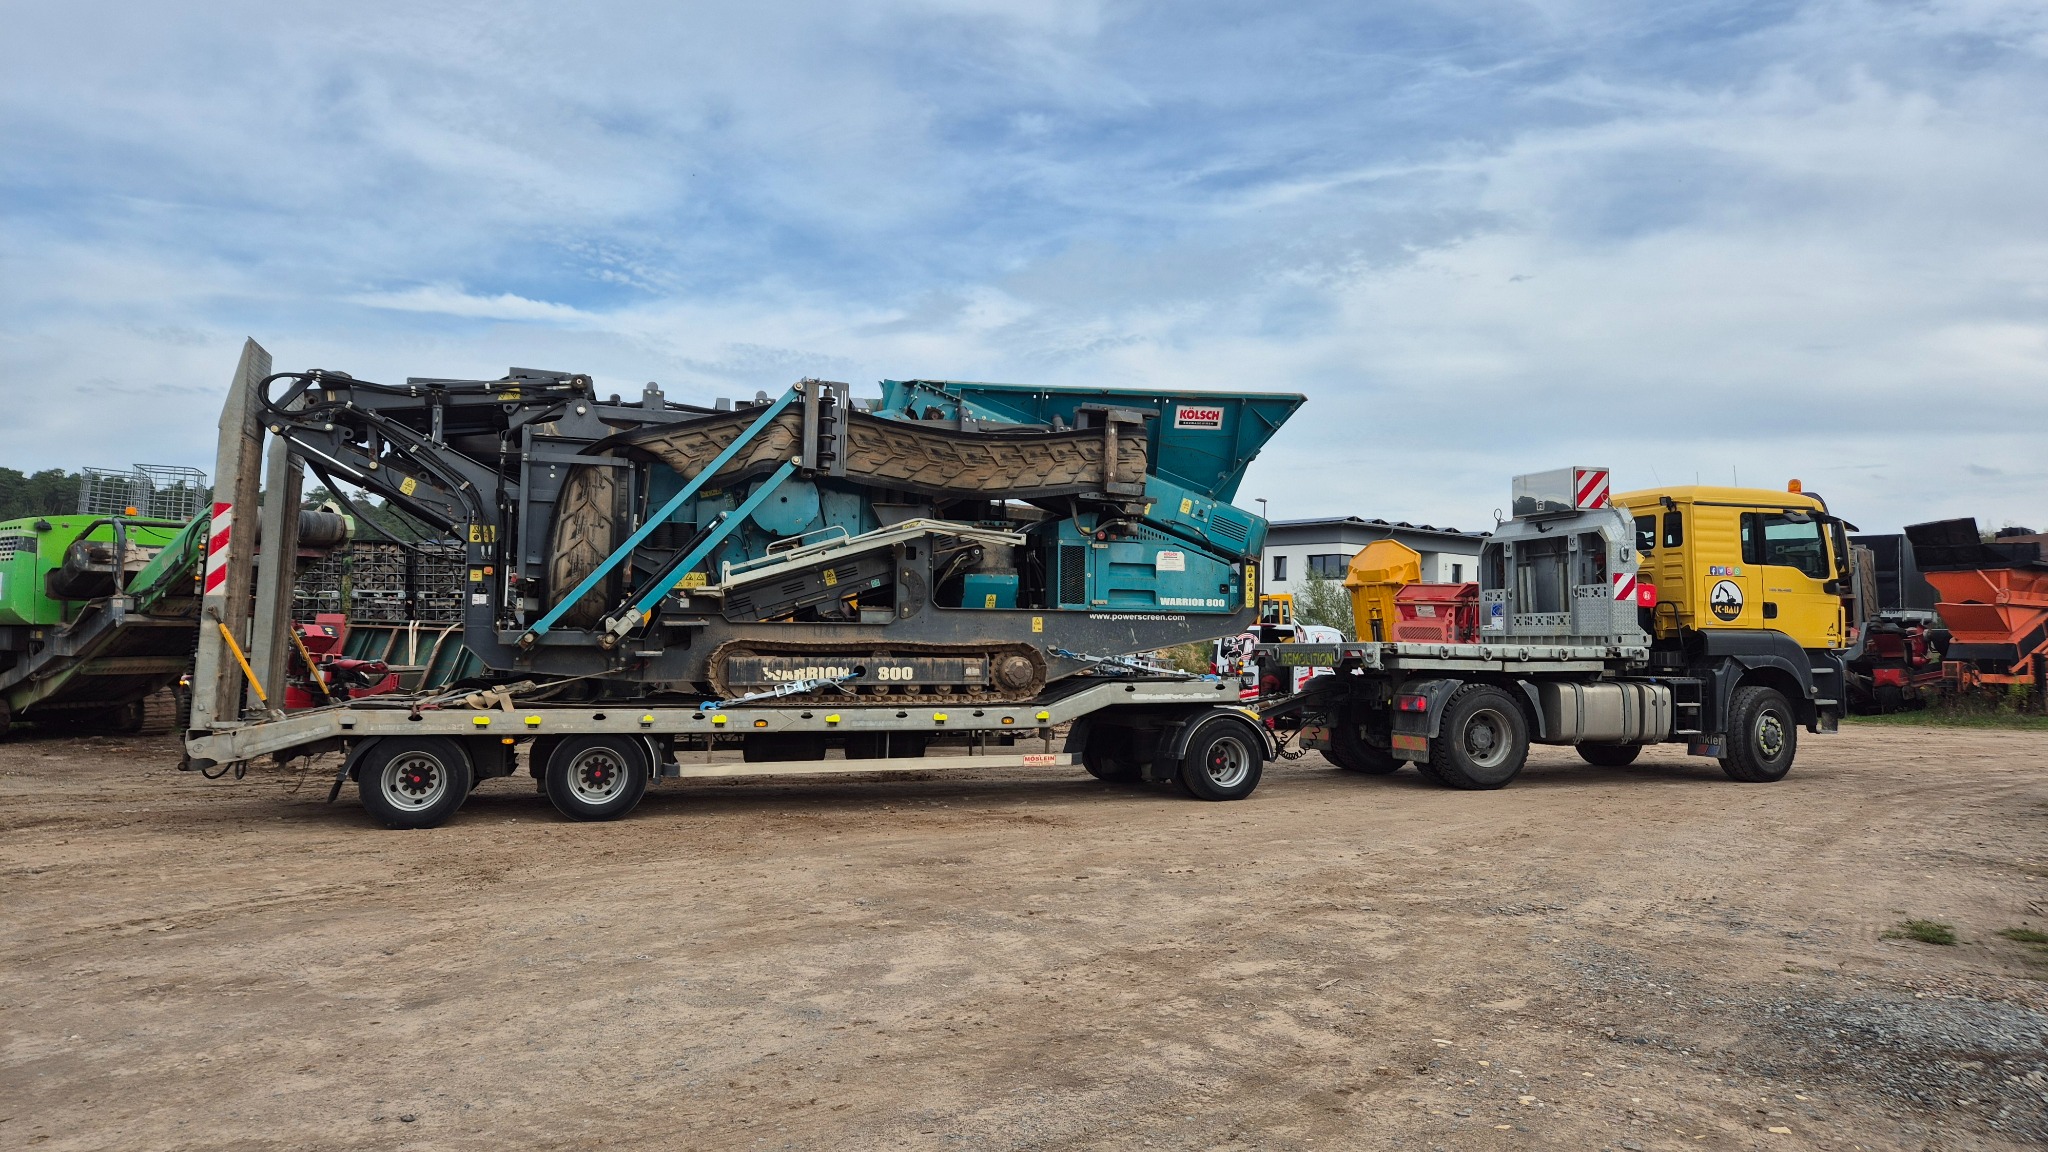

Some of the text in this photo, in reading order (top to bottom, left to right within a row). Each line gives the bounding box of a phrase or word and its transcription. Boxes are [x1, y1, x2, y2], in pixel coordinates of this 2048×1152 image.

[1179, 407, 1220, 421] KÖLSCH
[1160, 597, 1226, 607] WARRIOR 800
[1714, 604, 1740, 615] JC-BAU
[1089, 613, 1186, 621] www.powerscreen.com
[1282, 651, 1334, 666] DEMOLITION
[877, 666, 914, 681] 800
